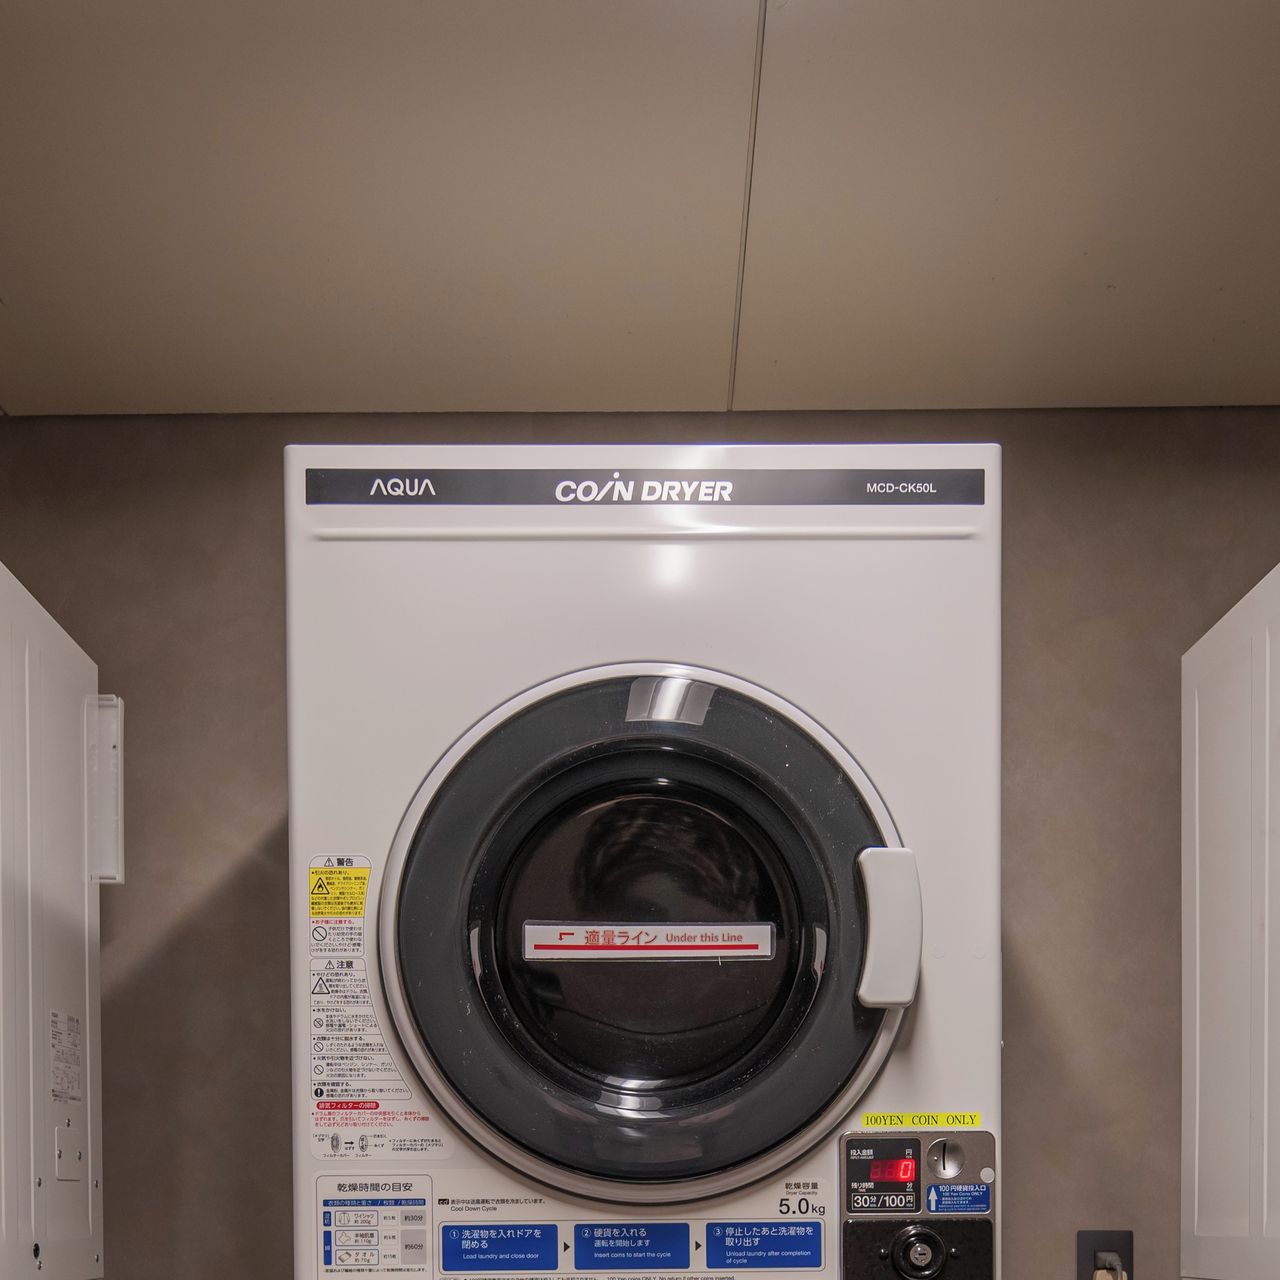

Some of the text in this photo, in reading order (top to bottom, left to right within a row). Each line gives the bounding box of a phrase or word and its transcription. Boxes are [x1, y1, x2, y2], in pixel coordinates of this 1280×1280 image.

[370, 478, 435, 496] AQUA
[556, 472, 735, 503] COIN DRYER
[867, 483, 936, 492] MCD-CK50L
[336, 857, 353, 867] 警告
[585, 930, 742, 946] 適量ライン Under this Line
[337, 961, 353, 969] 注意
[867, 1115, 976, 1125] 100YEN COIN ONLY
[338, 1183, 412, 1192] 乾燥時間の目安
